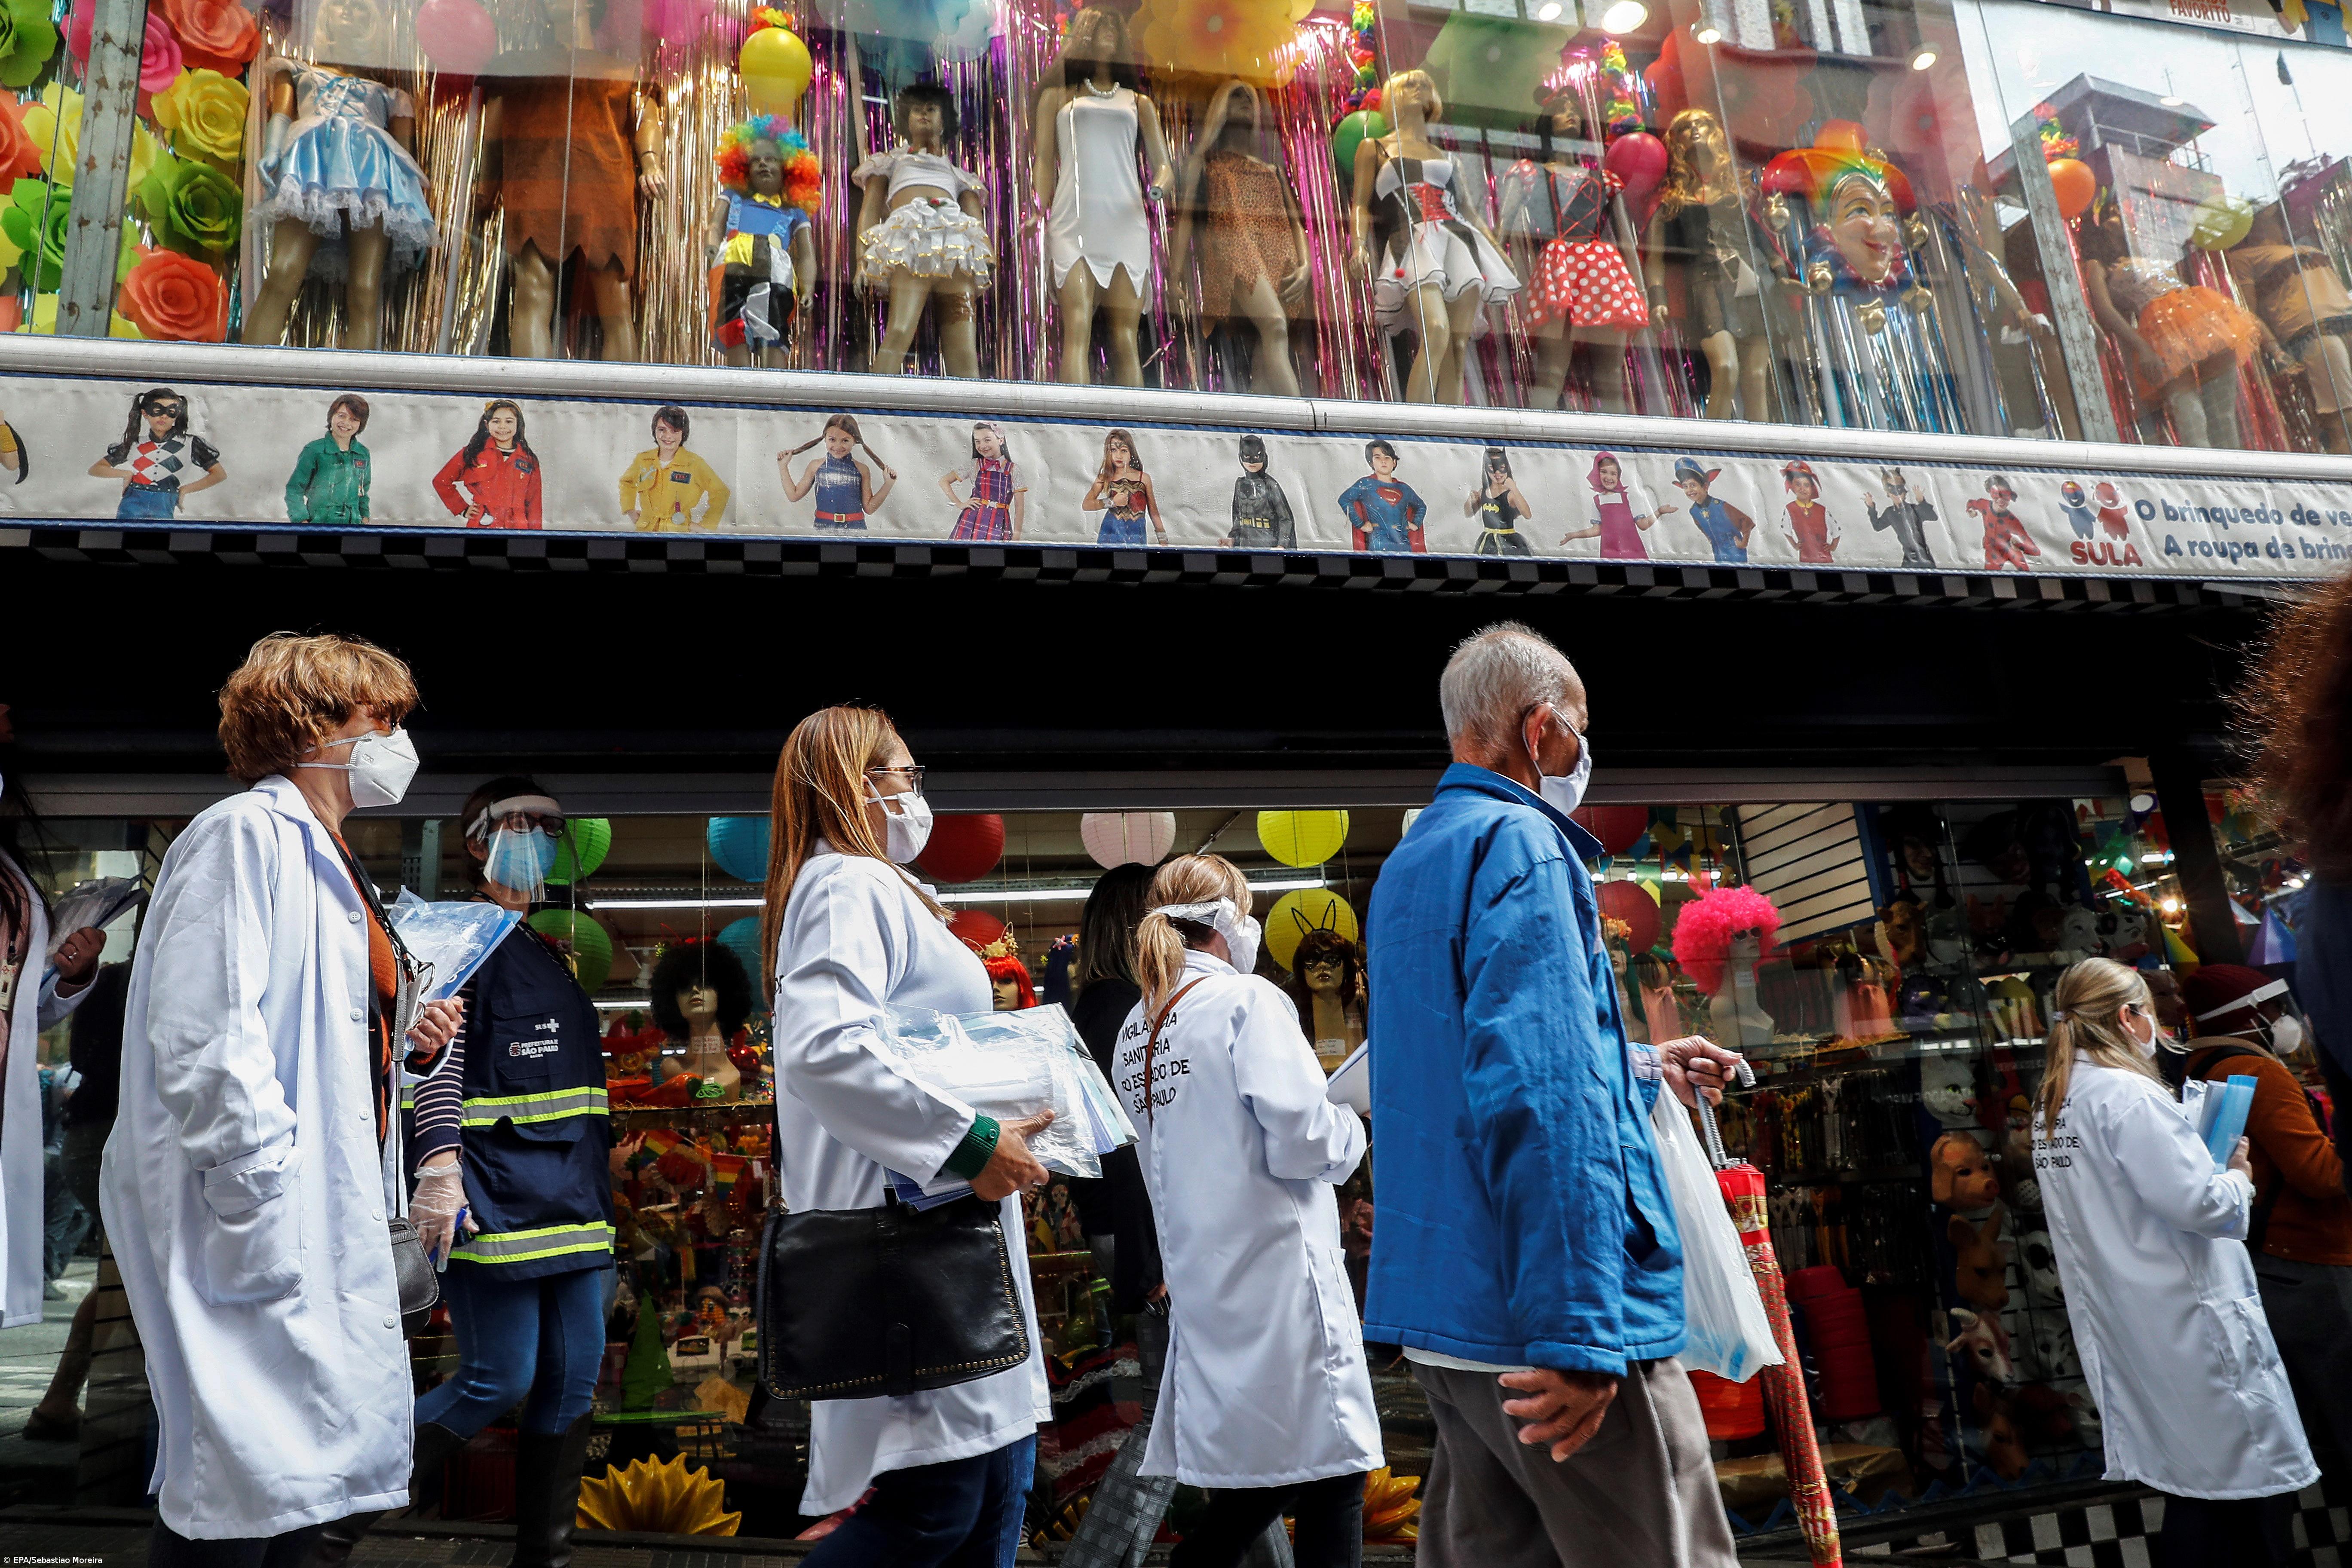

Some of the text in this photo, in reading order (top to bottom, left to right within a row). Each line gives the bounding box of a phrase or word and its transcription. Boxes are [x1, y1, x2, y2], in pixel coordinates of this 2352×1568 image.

[2169, 0, 2231, 23] FAVORITO
[2134, 498, 2352, 530] O brinquedo de ve
[2070, 539, 2143, 567] SULA
[2164, 534, 2184, 557] A
[2187, 539, 2259, 565] roupa
[2265, 535, 2296, 559] de
[1123, 1037, 1170, 1067] SANITRIA
[1132, 1063, 1167, 1090] ESADO
[1170, 1059, 1191, 1076] DE
[1152, 1086, 1176, 1109] PAULO
[2066, 1136, 2080, 1148] DE
